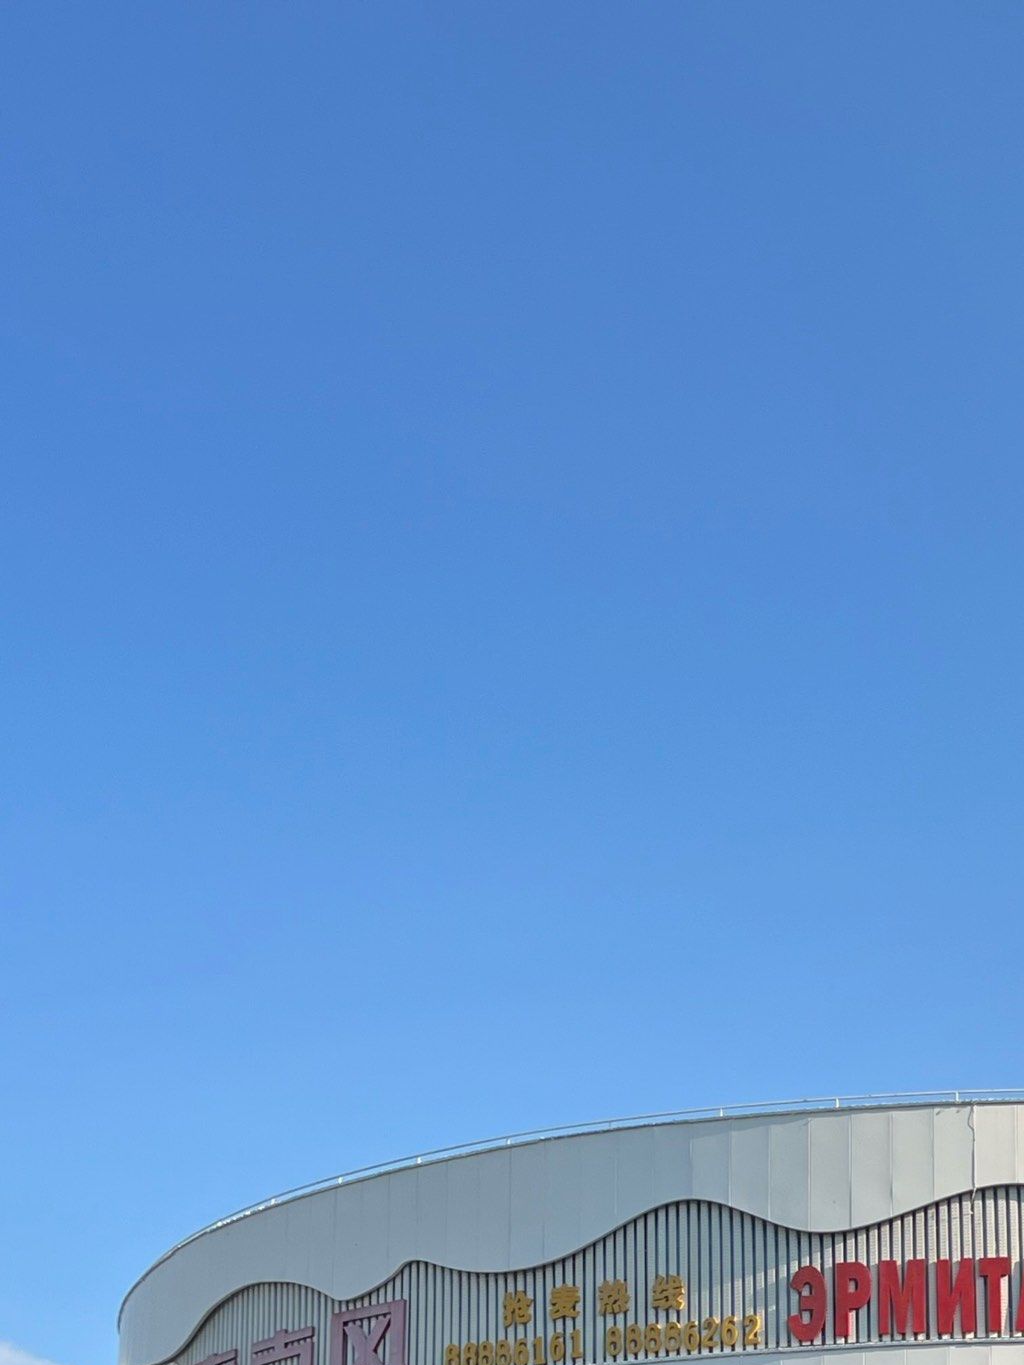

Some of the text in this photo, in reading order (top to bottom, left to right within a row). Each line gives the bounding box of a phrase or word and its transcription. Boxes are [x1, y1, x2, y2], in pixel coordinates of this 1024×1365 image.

[503, 1274, 686, 1328] 抢麦热线
[606, 1315, 761, 1357] 88886262
